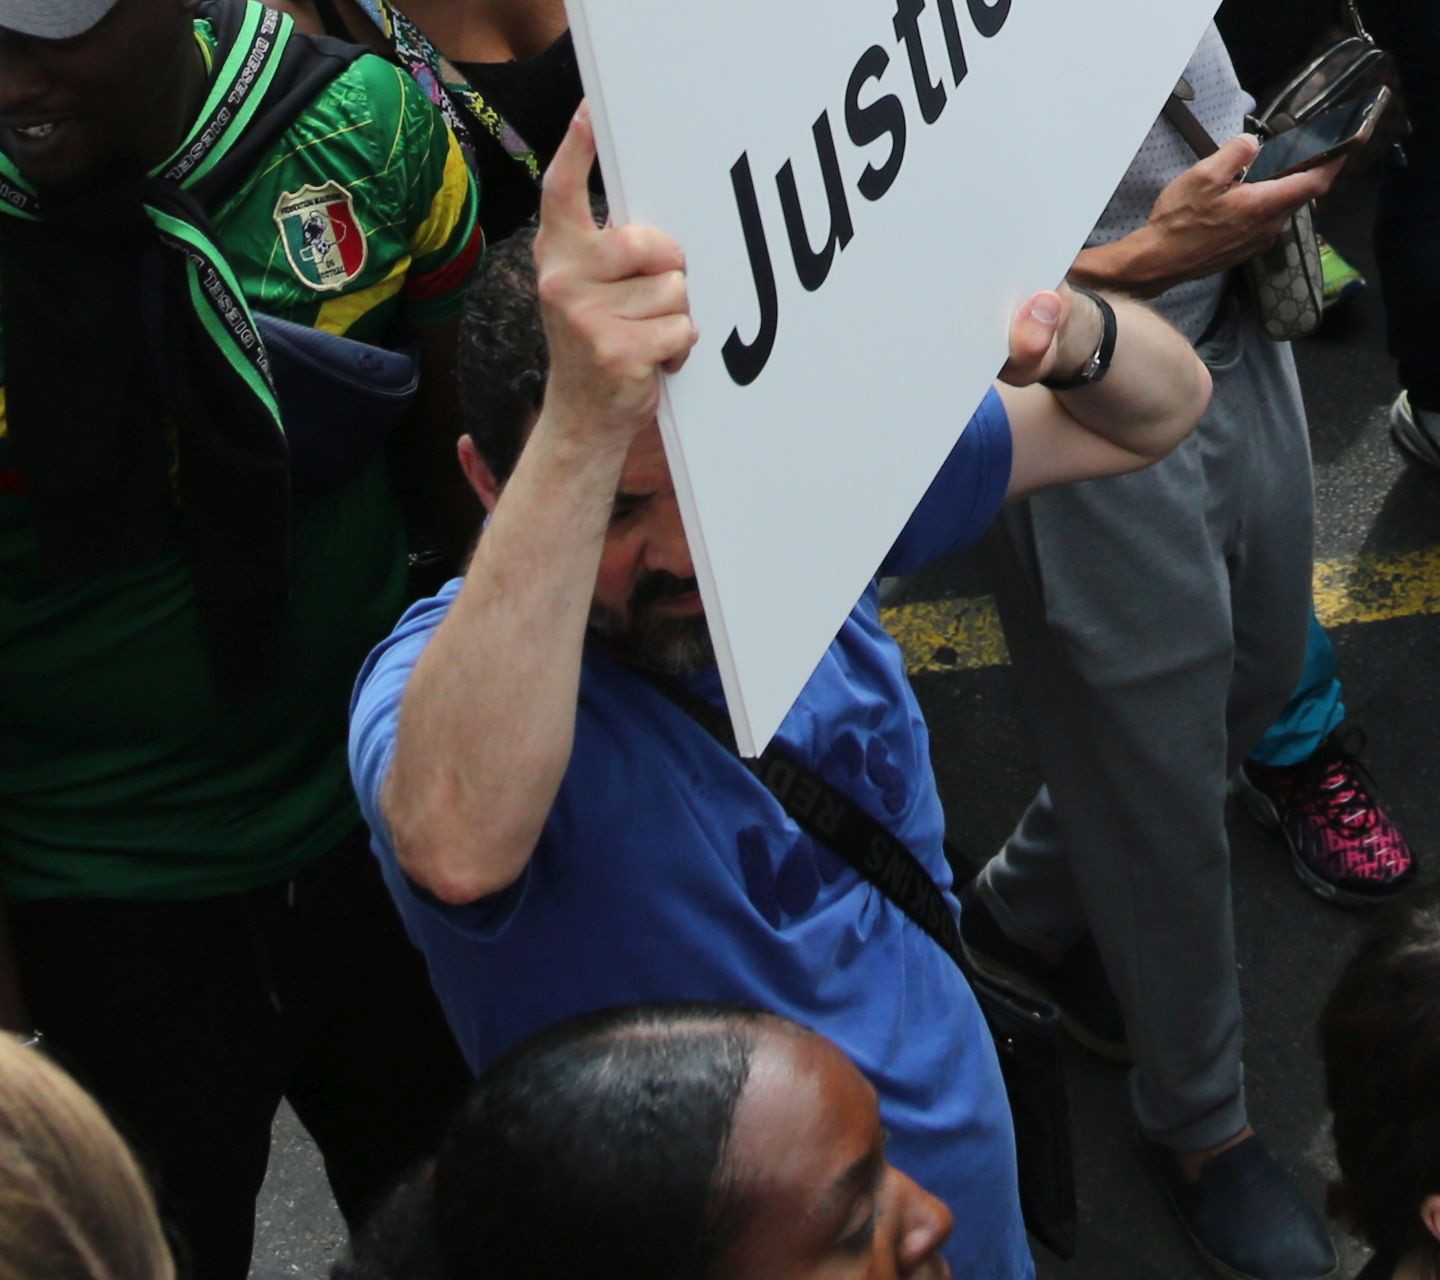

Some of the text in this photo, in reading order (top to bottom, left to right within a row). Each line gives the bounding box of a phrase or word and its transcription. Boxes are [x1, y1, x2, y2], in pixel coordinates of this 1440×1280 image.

[227, 39, 269, 106] DIESEL
[165, 107, 231, 183] DIESEL
[204, 268, 255, 351] DIESEL
